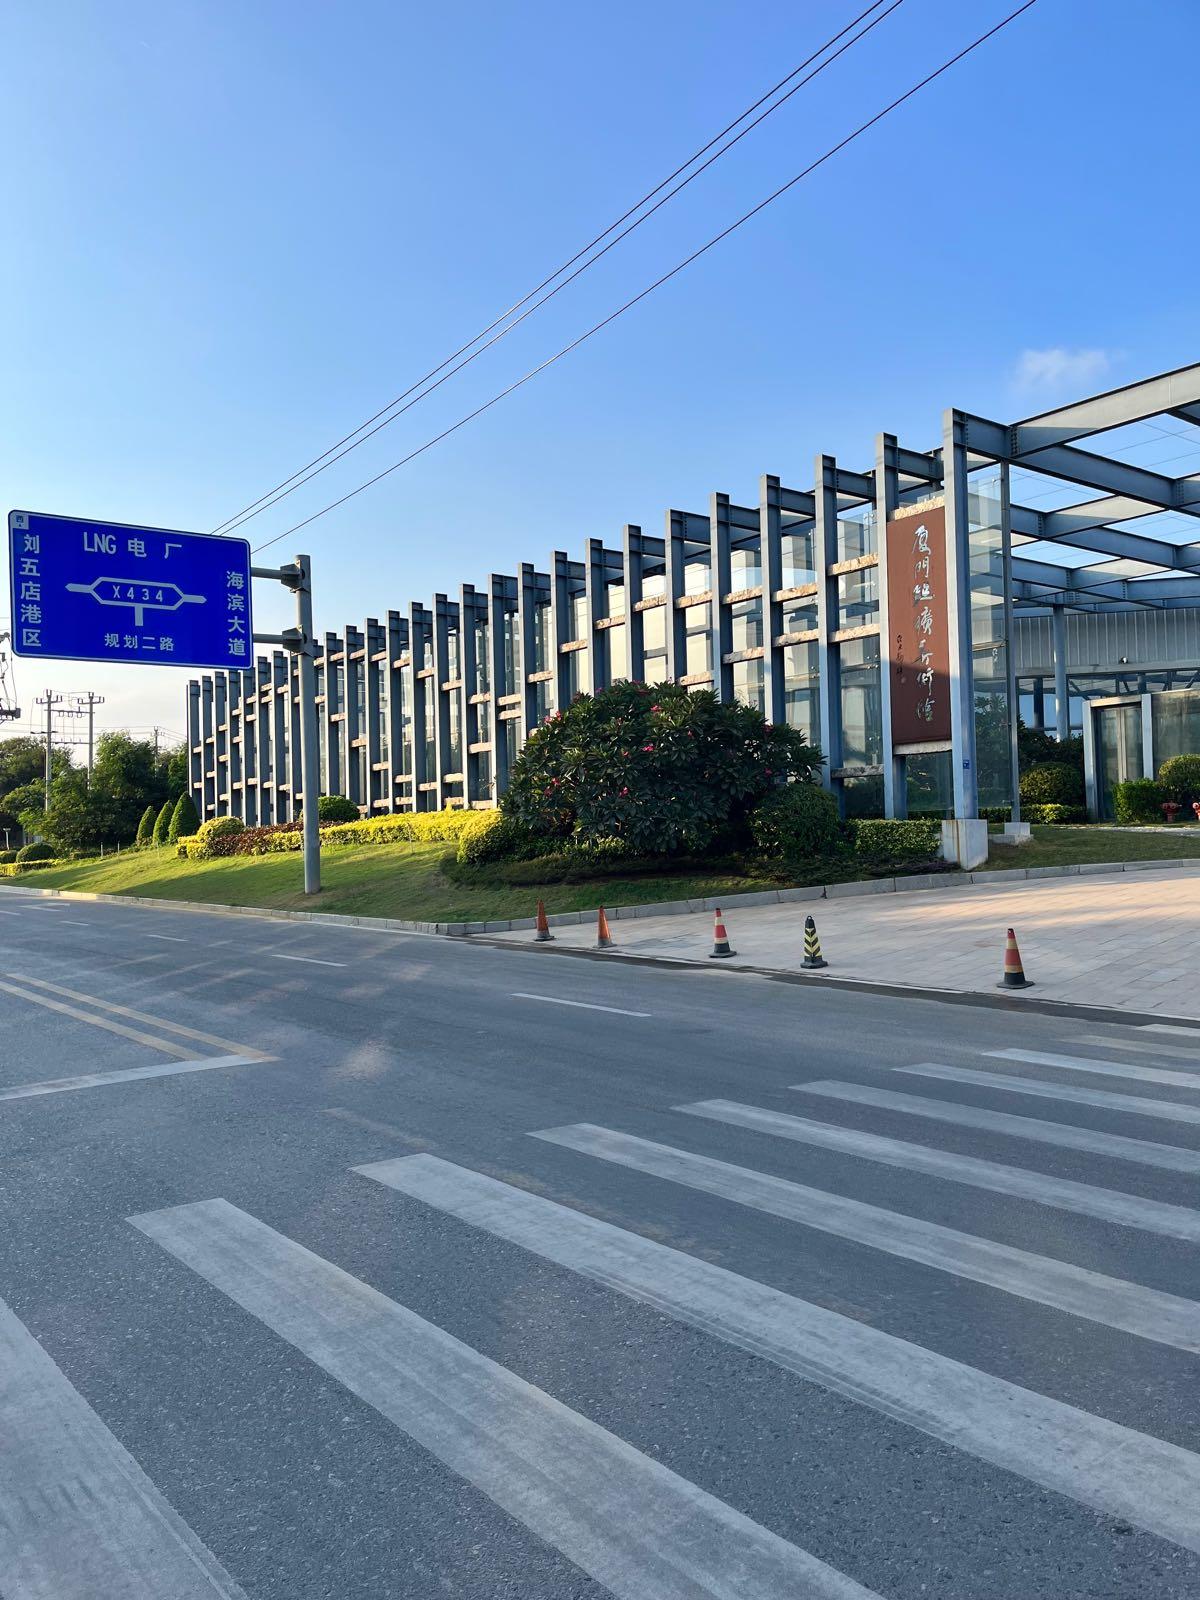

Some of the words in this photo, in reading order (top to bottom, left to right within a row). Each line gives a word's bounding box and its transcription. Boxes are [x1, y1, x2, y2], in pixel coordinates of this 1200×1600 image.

[83, 532, 116, 554] LNG
[19, 534, 41, 647] 刘五店港区
[226, 571, 245, 656] 海滨大道
[104, 634, 174, 651] 规划二路
